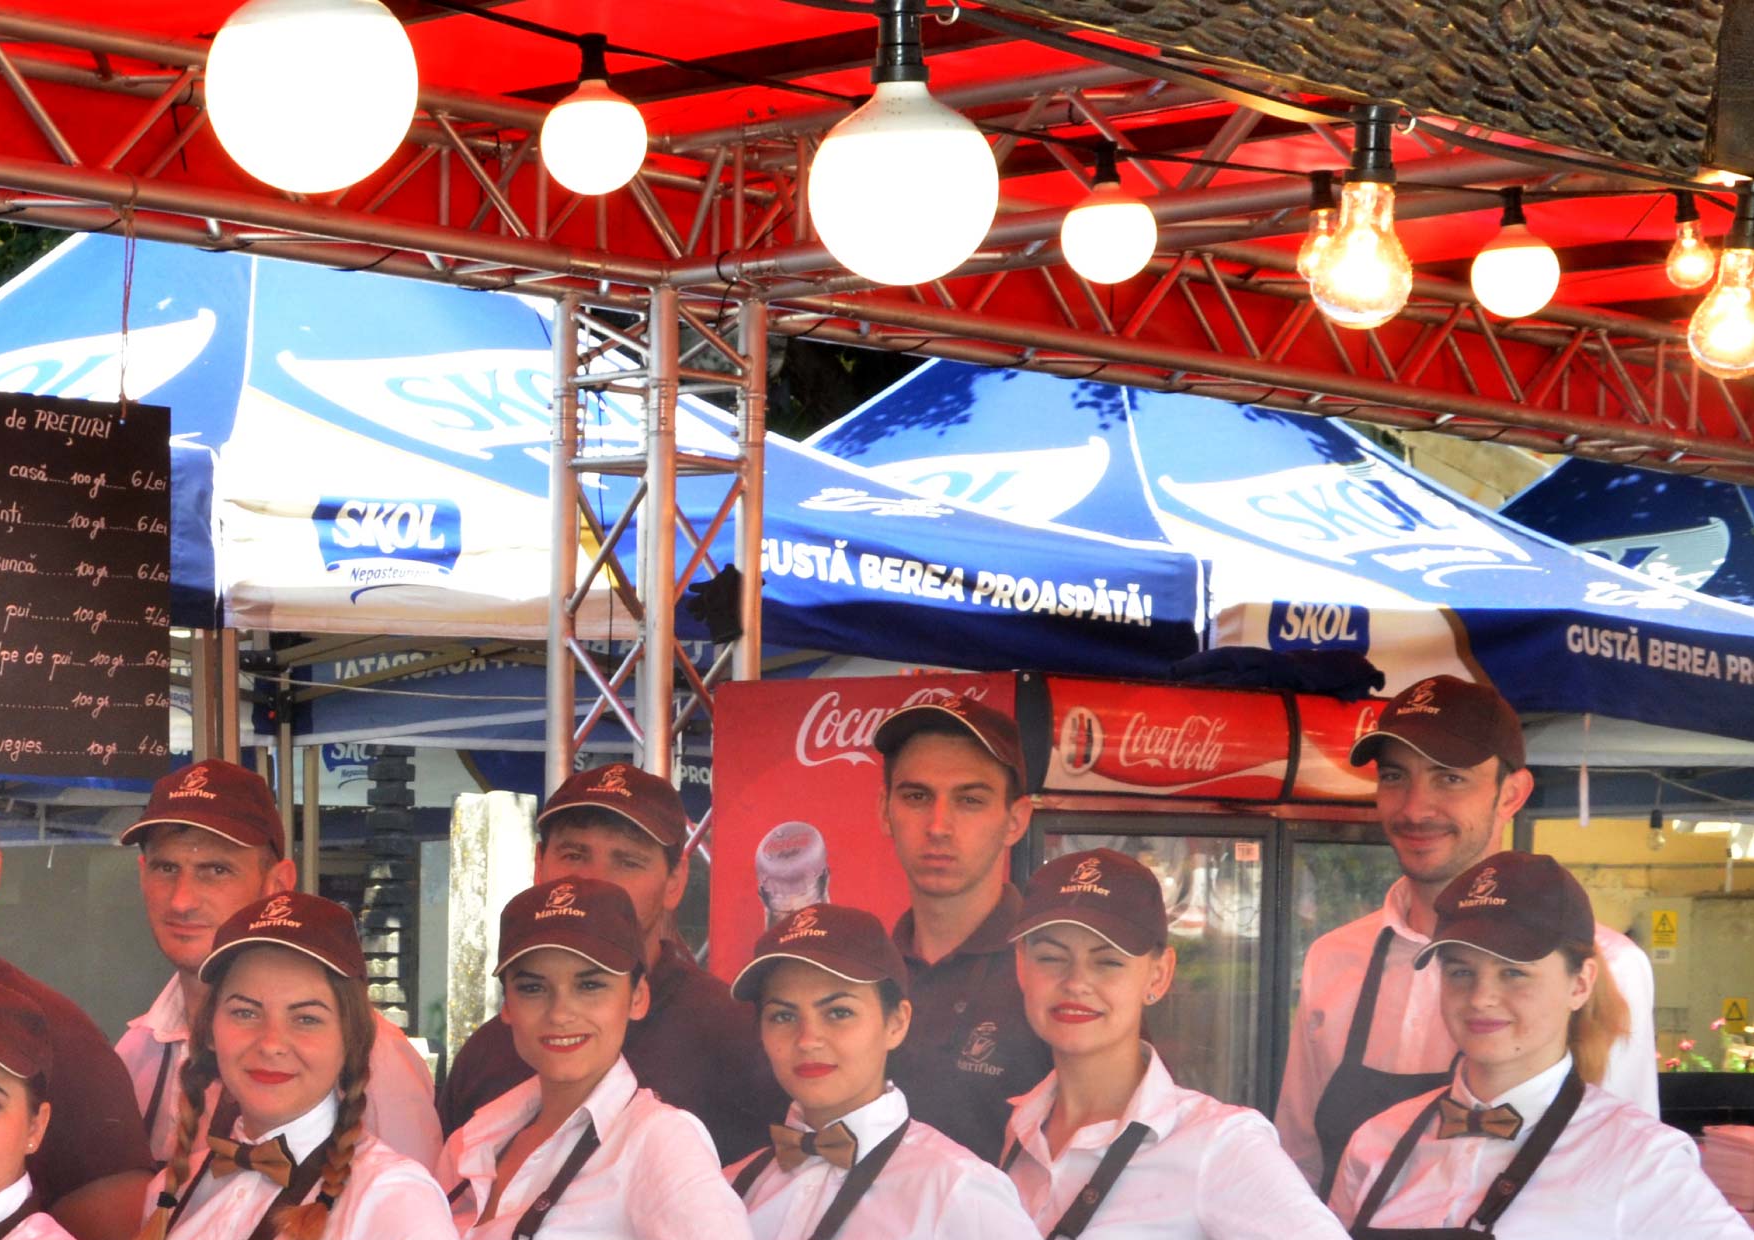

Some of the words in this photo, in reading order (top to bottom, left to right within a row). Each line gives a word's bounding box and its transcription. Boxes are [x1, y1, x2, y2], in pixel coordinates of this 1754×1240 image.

[5, 408, 27, 430] de
[144, 472, 167, 491] Lei
[332, 500, 446, 553] SKOL
[860, 553, 964, 602] BEREA
[973, 570, 1152, 627] PROASPĂTĂ!
[3, 602, 31, 633] pui
[1279, 602, 1358, 643] SKOL
[24, 645, 44, 665] de
[1567, 625, 1642, 664] GUSTĂ
[1647, 638, 1721, 679] BEREA
[169, 789, 218, 801] Mariflor
[249, 918, 303, 932] Mariflor
[535, 907, 587, 921] Mariflor
